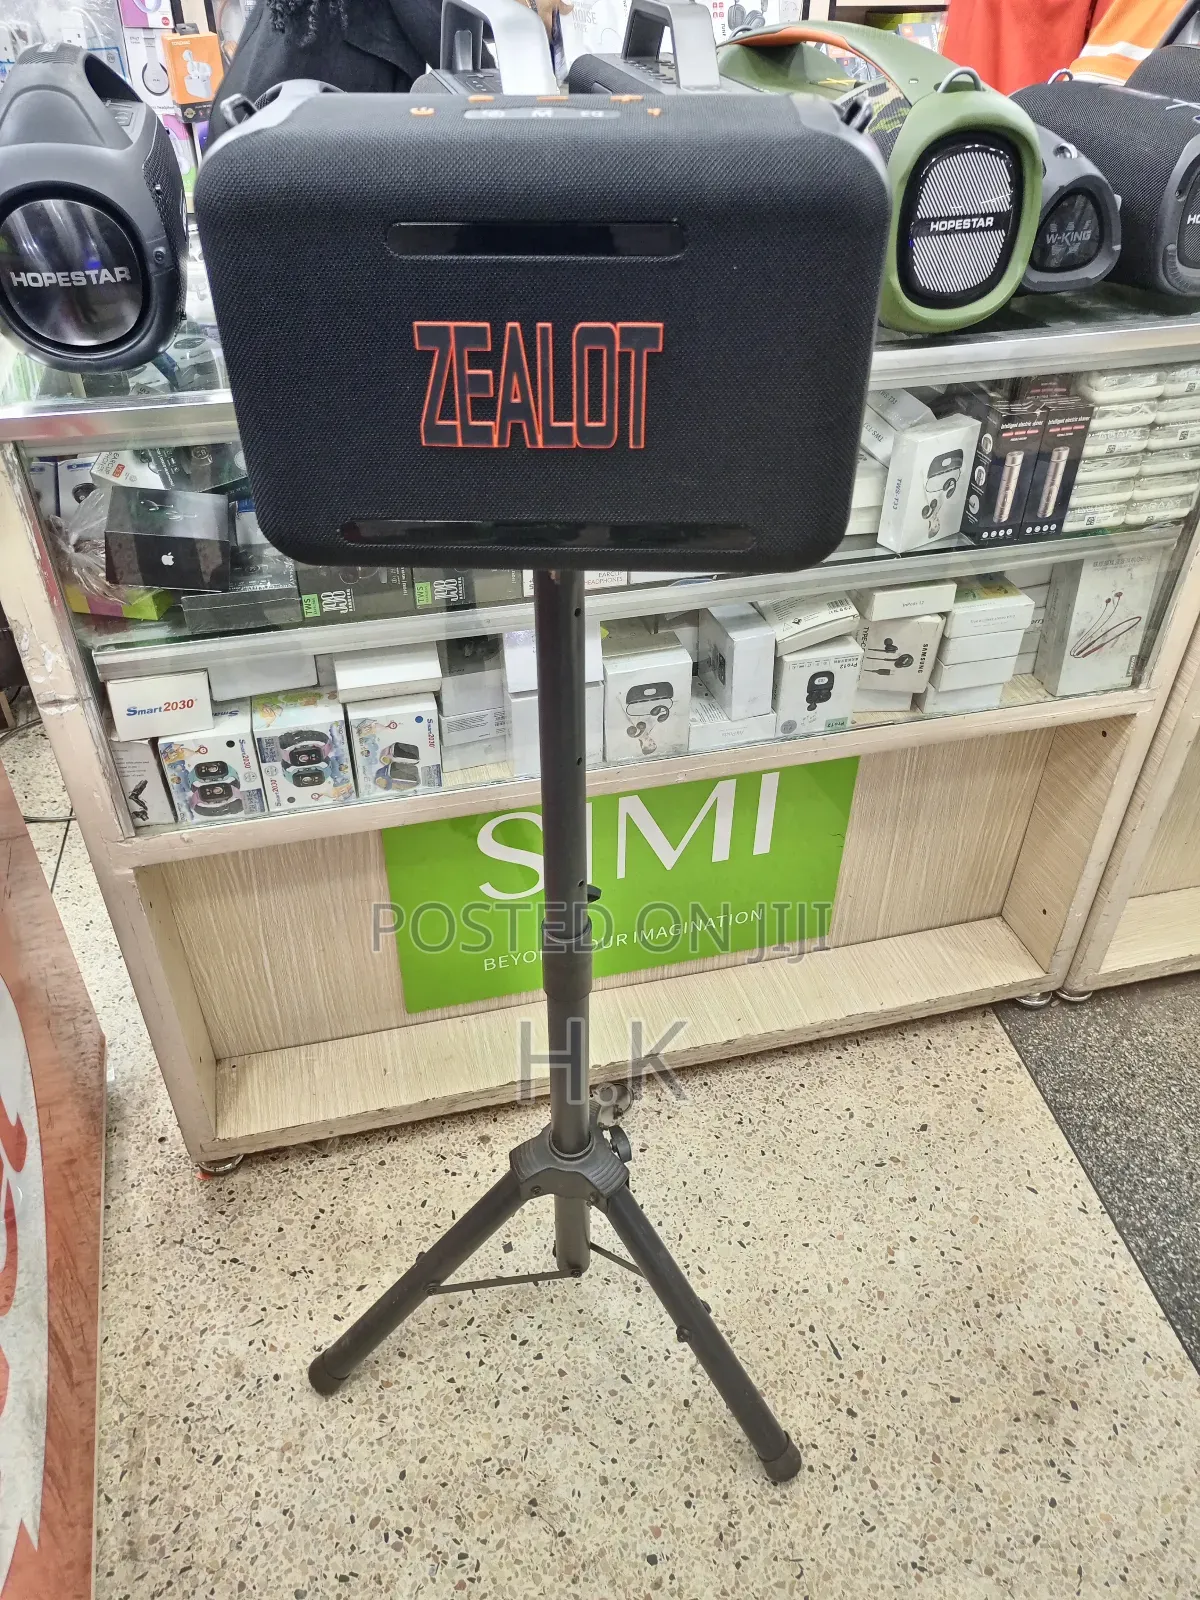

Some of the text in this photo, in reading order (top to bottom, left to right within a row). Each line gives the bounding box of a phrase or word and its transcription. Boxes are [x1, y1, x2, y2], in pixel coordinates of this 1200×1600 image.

[930, 217, 994, 232] HOPESTAR
[1046, 230, 1092, 246] W-KING
[9, 266, 131, 287] HOPESTAR
[412, 320, 664, 449] ZEALOT
[417, 586, 425, 603] TWS
[304, 598, 313, 616] TWS
[917, 643, 929, 674] SAMSUNG
[476, 771, 780, 900] SIMI
[484, 948, 543, 971] BEYO
[633, 908, 763, 943] IMAGINATION
